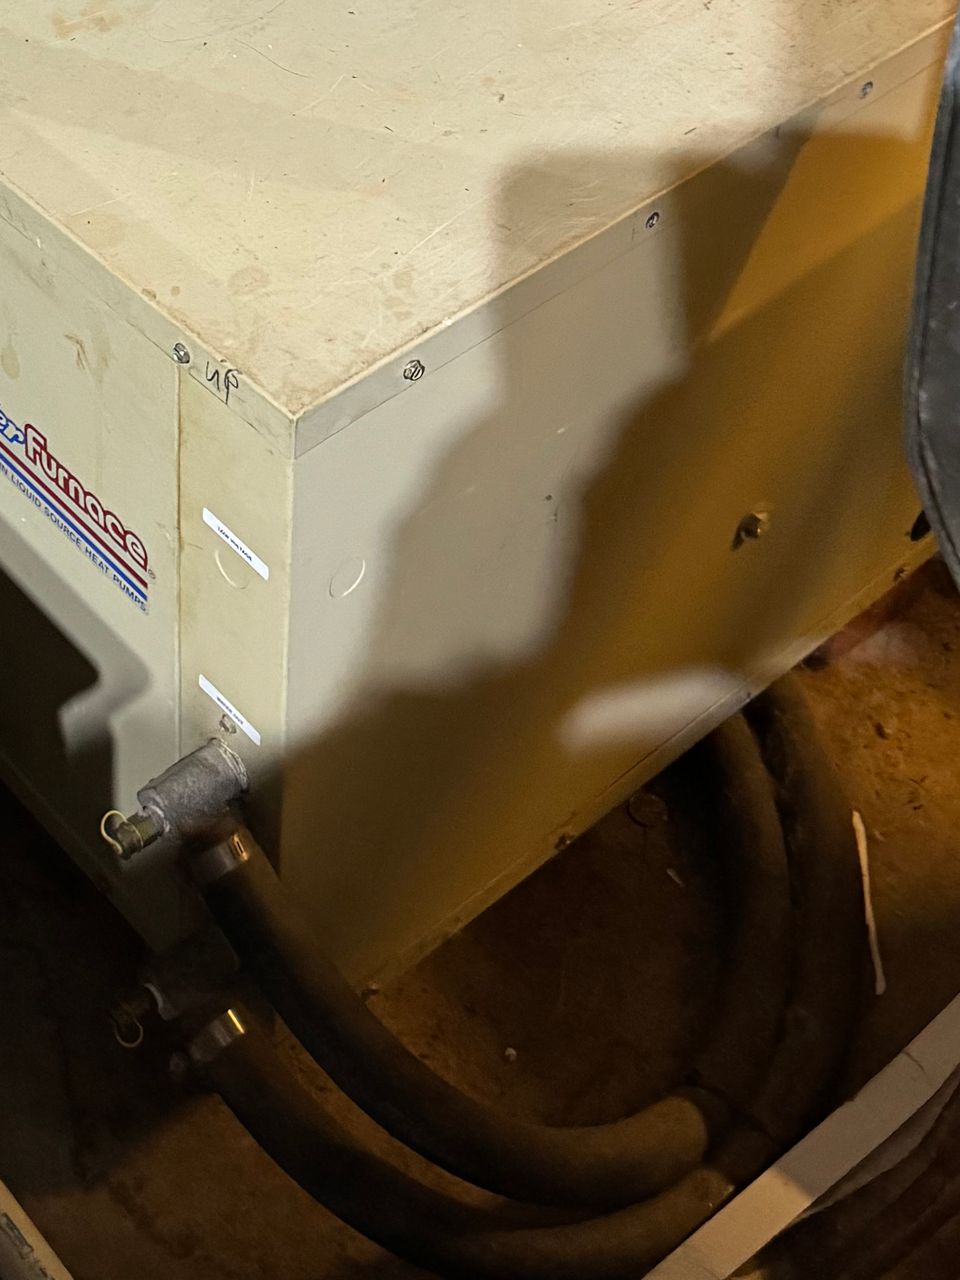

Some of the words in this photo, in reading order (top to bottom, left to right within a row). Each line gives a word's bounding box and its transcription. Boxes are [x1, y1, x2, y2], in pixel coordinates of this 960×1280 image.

[0, 462, 8, 475] IN
[11, 475, 42, 507] LIQUID
[44, 506, 81, 549] SOURCE
[85, 546, 110, 573] HEAT
